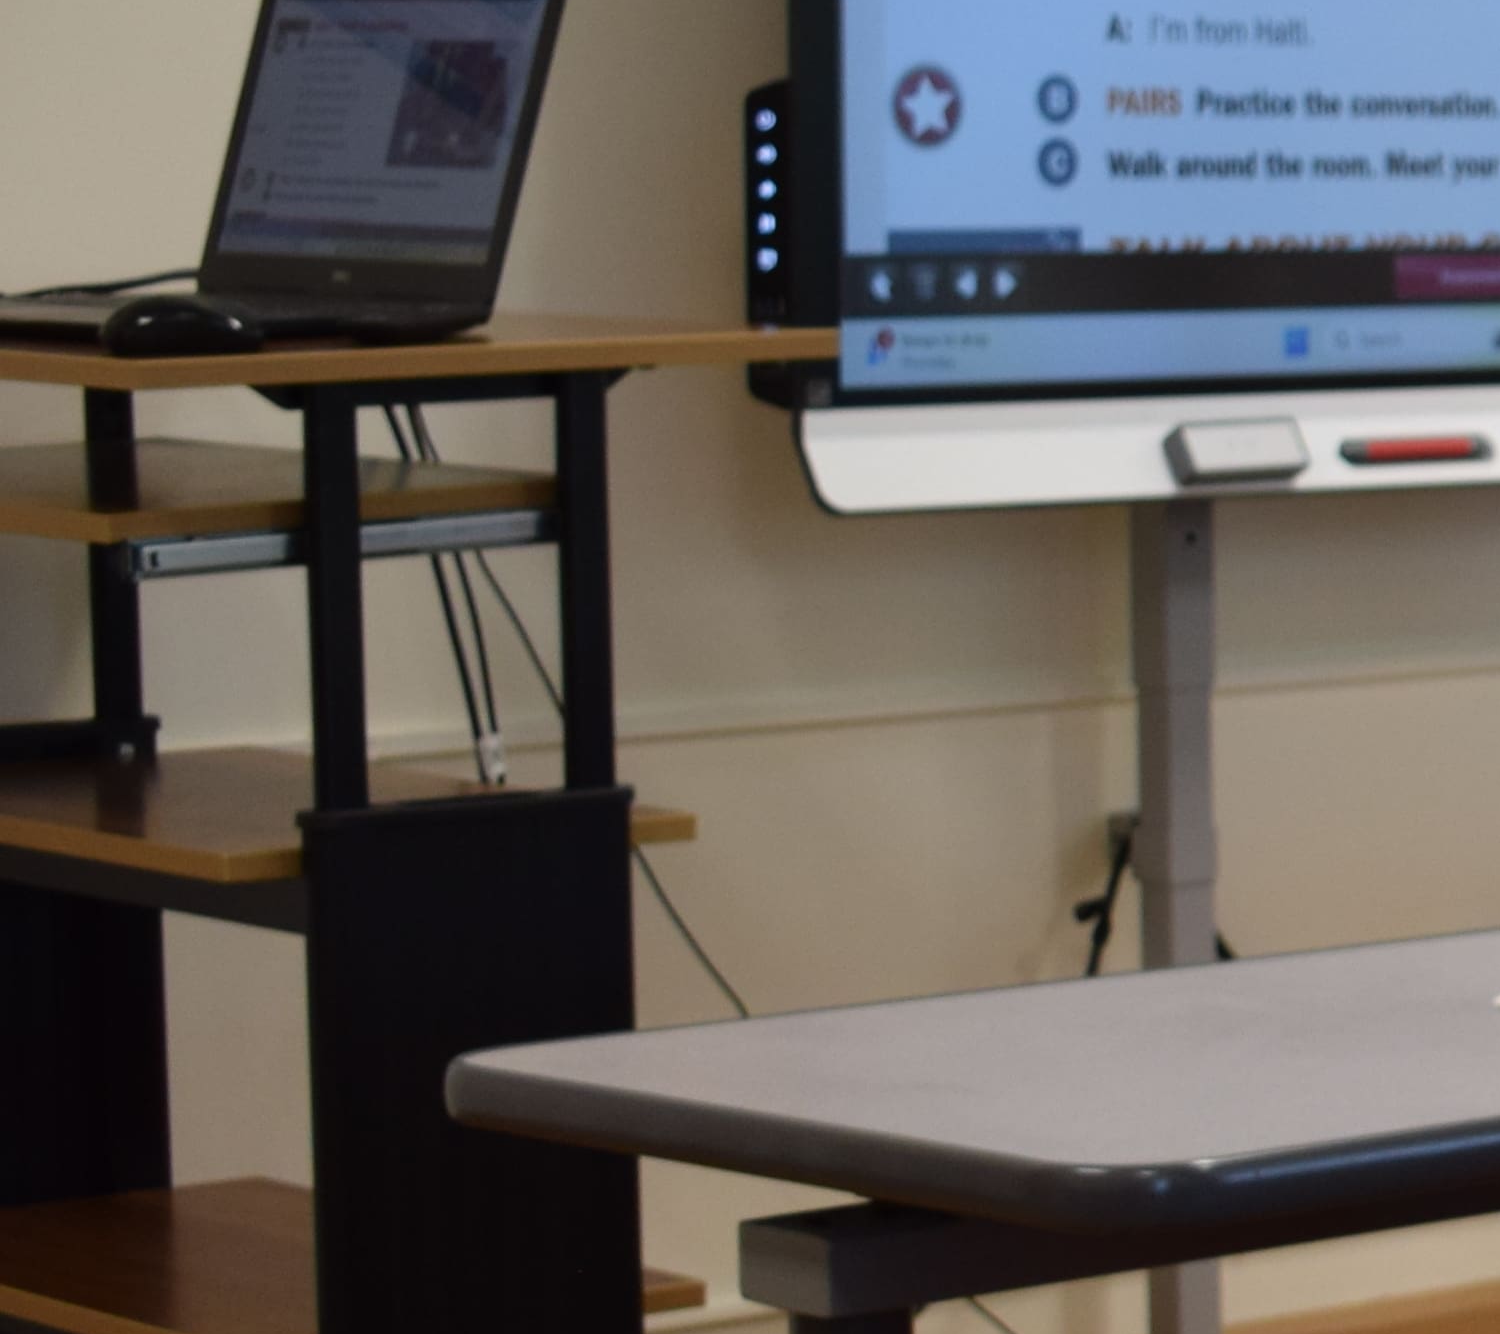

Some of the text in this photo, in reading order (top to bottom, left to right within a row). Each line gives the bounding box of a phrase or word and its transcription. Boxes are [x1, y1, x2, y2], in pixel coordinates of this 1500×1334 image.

[1106, 15, 1130, 43] A:
[1149, 16, 1188, 45] I'm
[1195, 16, 1247, 45] from
[1107, 88, 1182, 116] PAIRS
[1197, 87, 1293, 119] Practice
[1305, 88, 1340, 117] the
[1106, 149, 1166, 180] Walk
[1175, 150, 1257, 180] around
[1266, 151, 1302, 180] the
[1312, 156, 1374, 181] room.
[1387, 151, 1445, 181] Meet
[1453, 157, 1498, 186] your
